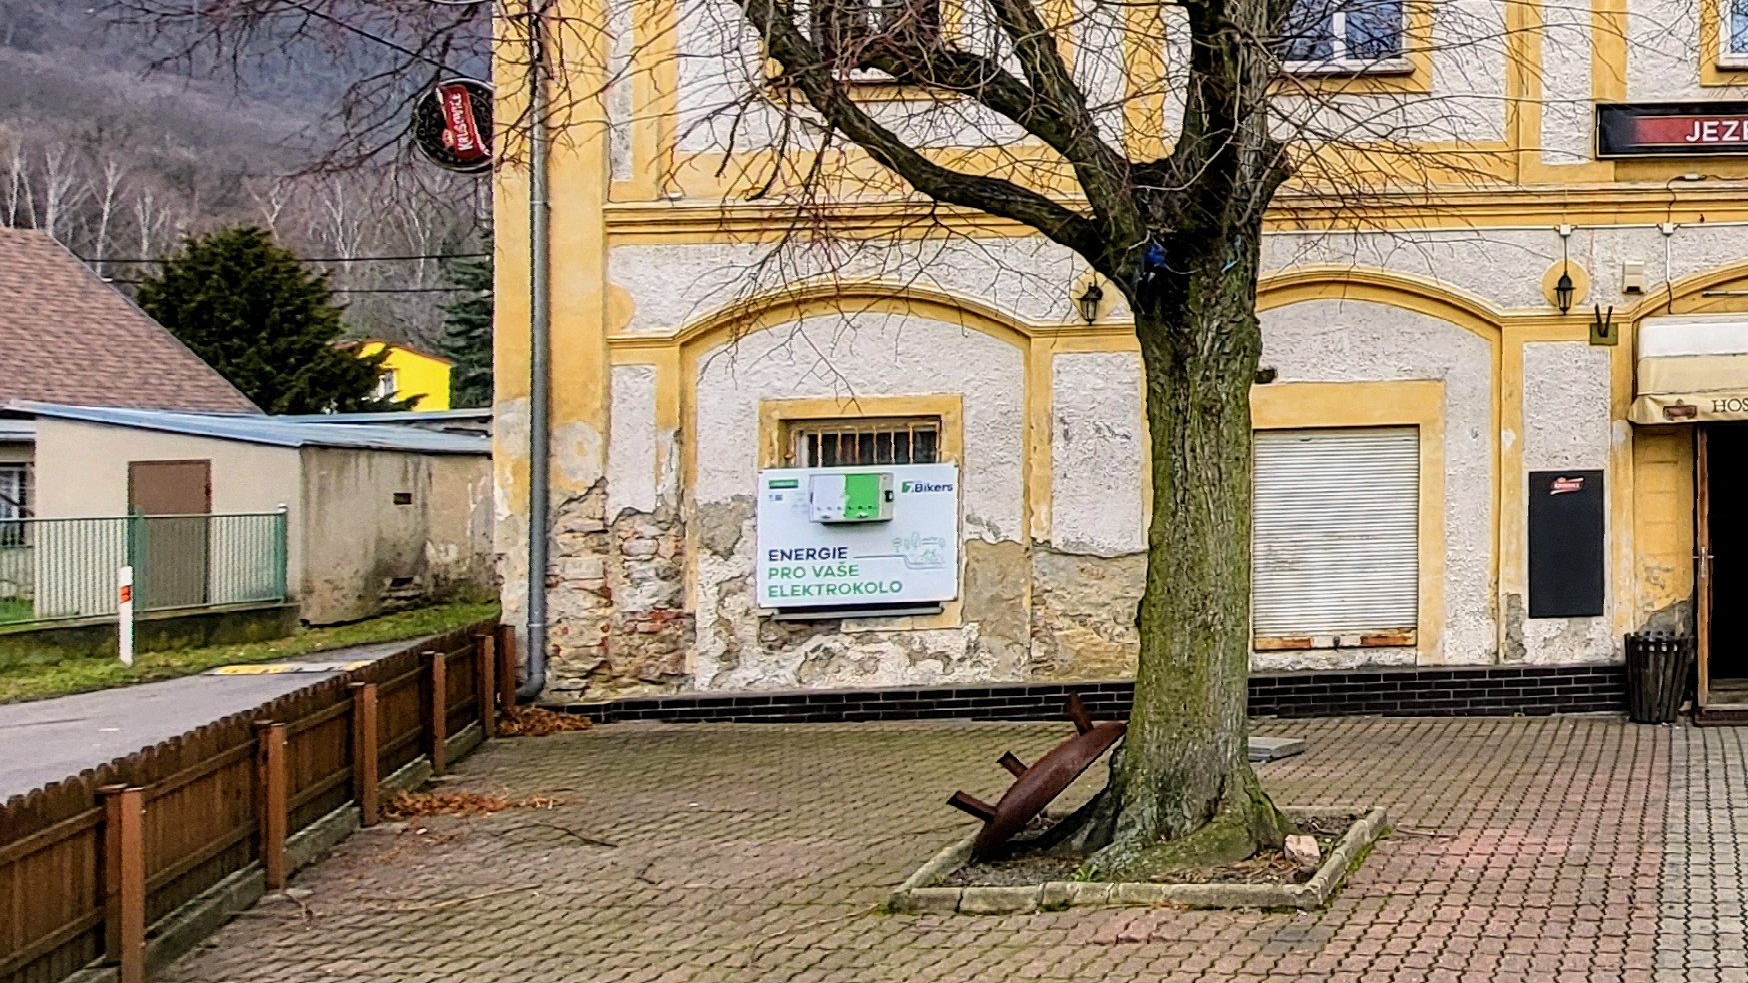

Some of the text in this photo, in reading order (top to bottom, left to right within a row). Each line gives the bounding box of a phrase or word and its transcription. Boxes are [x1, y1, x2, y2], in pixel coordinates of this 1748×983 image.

[768, 547, 849, 562] ENERGIE
[768, 561, 860, 579] PRO VAŠE
[768, 580, 903, 598] ELEKTROKOLO
